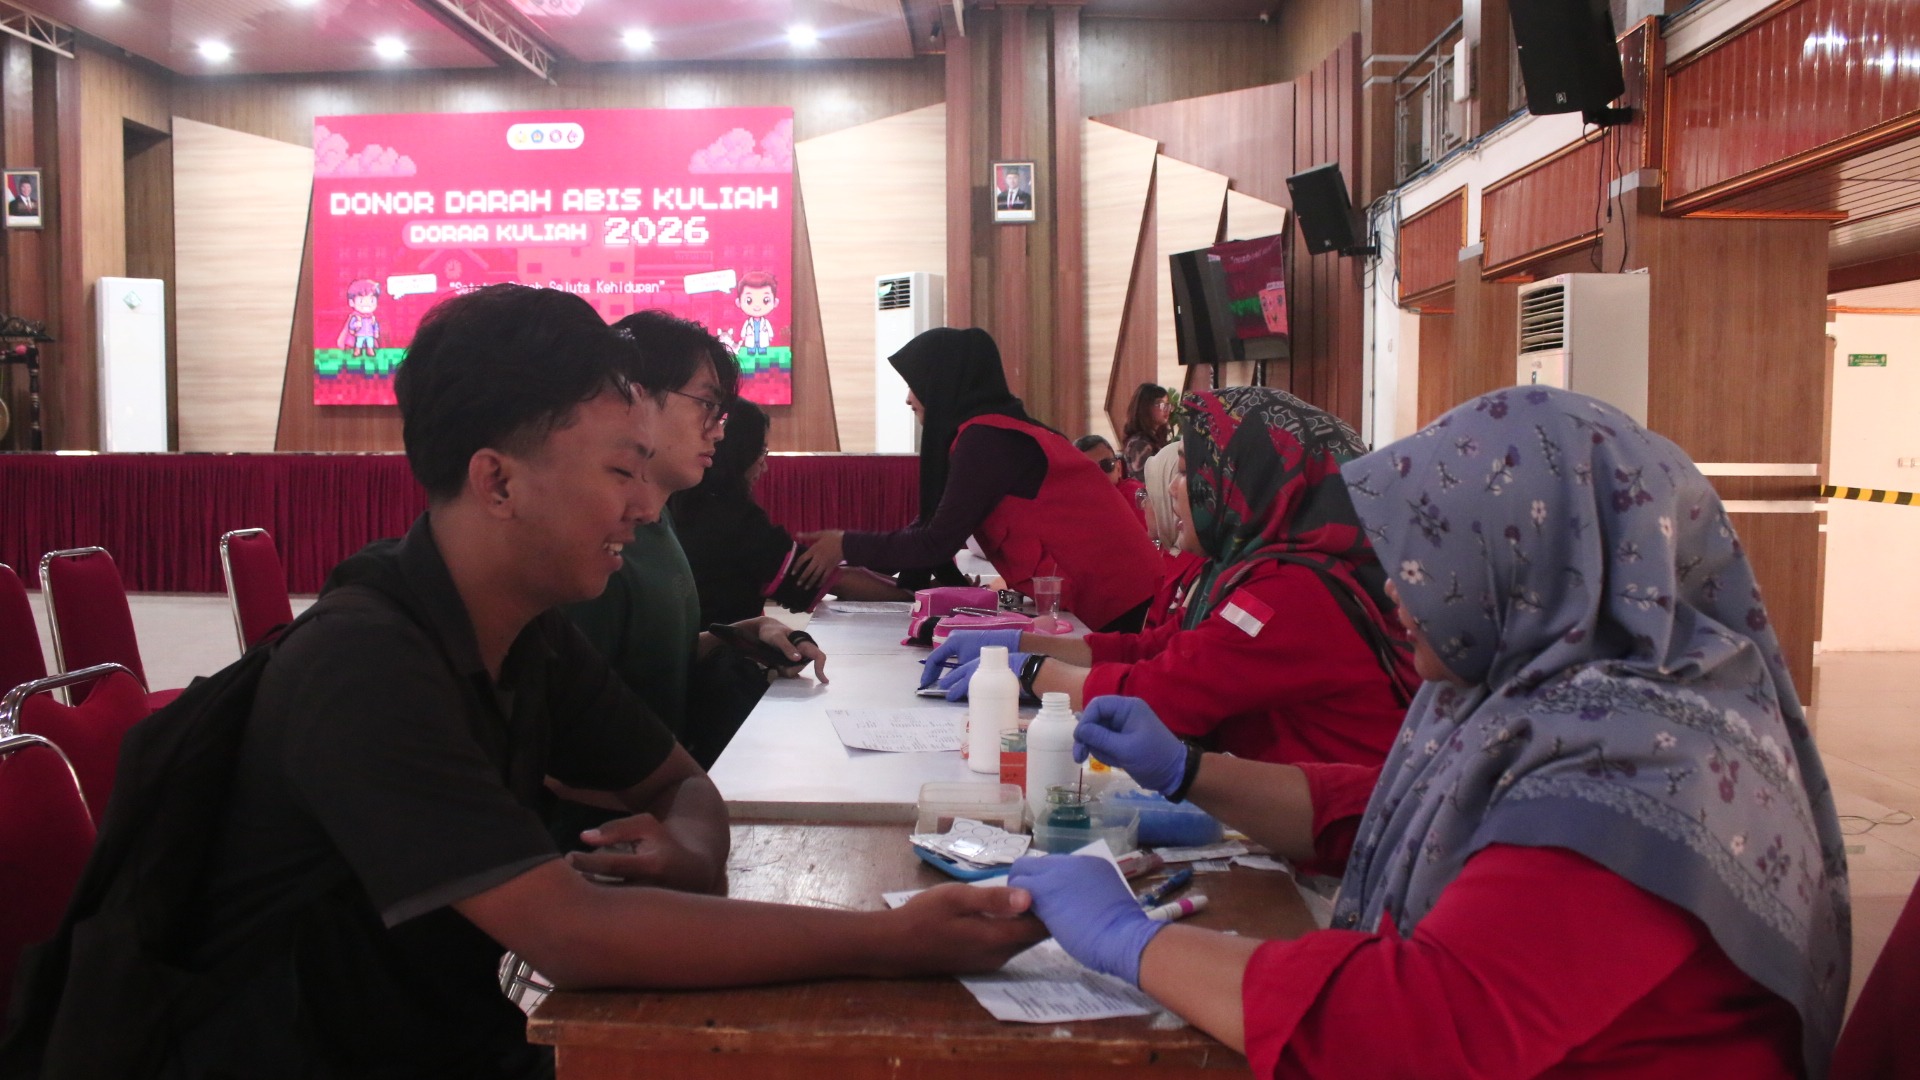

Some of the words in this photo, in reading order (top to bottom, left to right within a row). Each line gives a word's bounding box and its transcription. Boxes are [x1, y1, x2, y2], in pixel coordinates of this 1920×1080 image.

[330, 191, 434, 215] DONOR
[445, 189, 551, 213] DARAH
[562, 188, 642, 211] ABIS
[653, 186, 778, 210] KULIAH
[410, 224, 489, 243] DORAA
[496, 223, 587, 242] KULIAH
[604, 216, 710, 245] 2026
